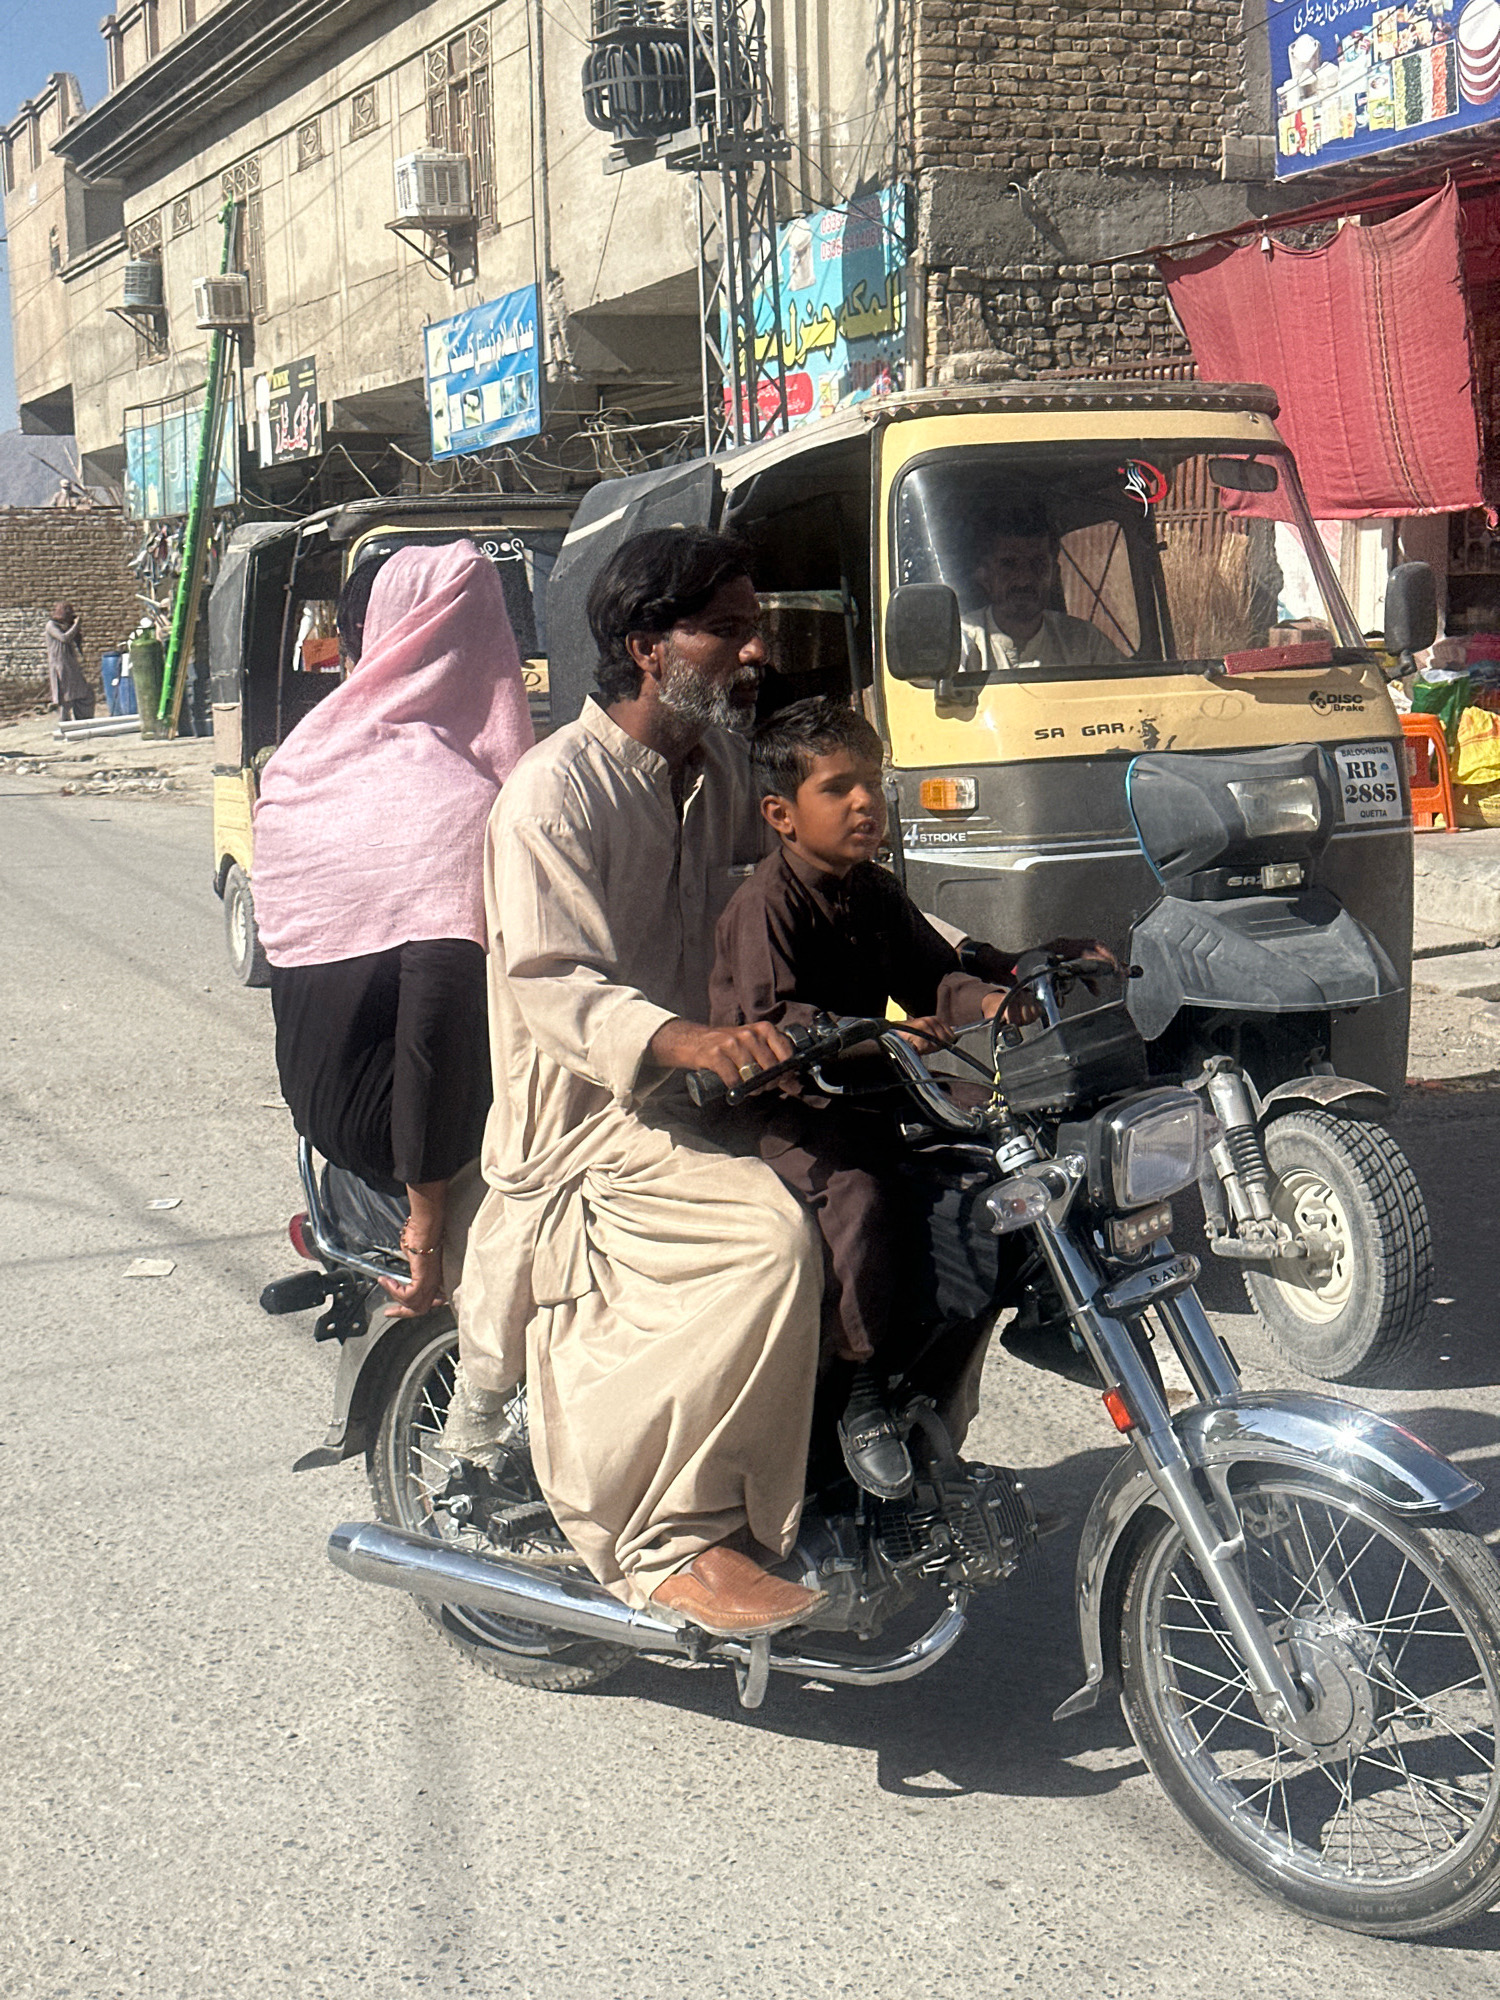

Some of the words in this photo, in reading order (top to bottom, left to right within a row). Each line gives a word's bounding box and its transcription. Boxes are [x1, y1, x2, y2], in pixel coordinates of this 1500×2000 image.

[1326, 693, 1363, 704] DISC
[1333, 704, 1365, 712] Brake
[1341, 746, 1389, 757] BALOCHISTAN
[1345, 760, 1378, 779] RB
[1345, 783, 1397, 804] 2885
[1360, 809, 1387, 818] QUETTA
[903, 823, 919, 847] 4
[919, 832, 967, 842] STROKE
